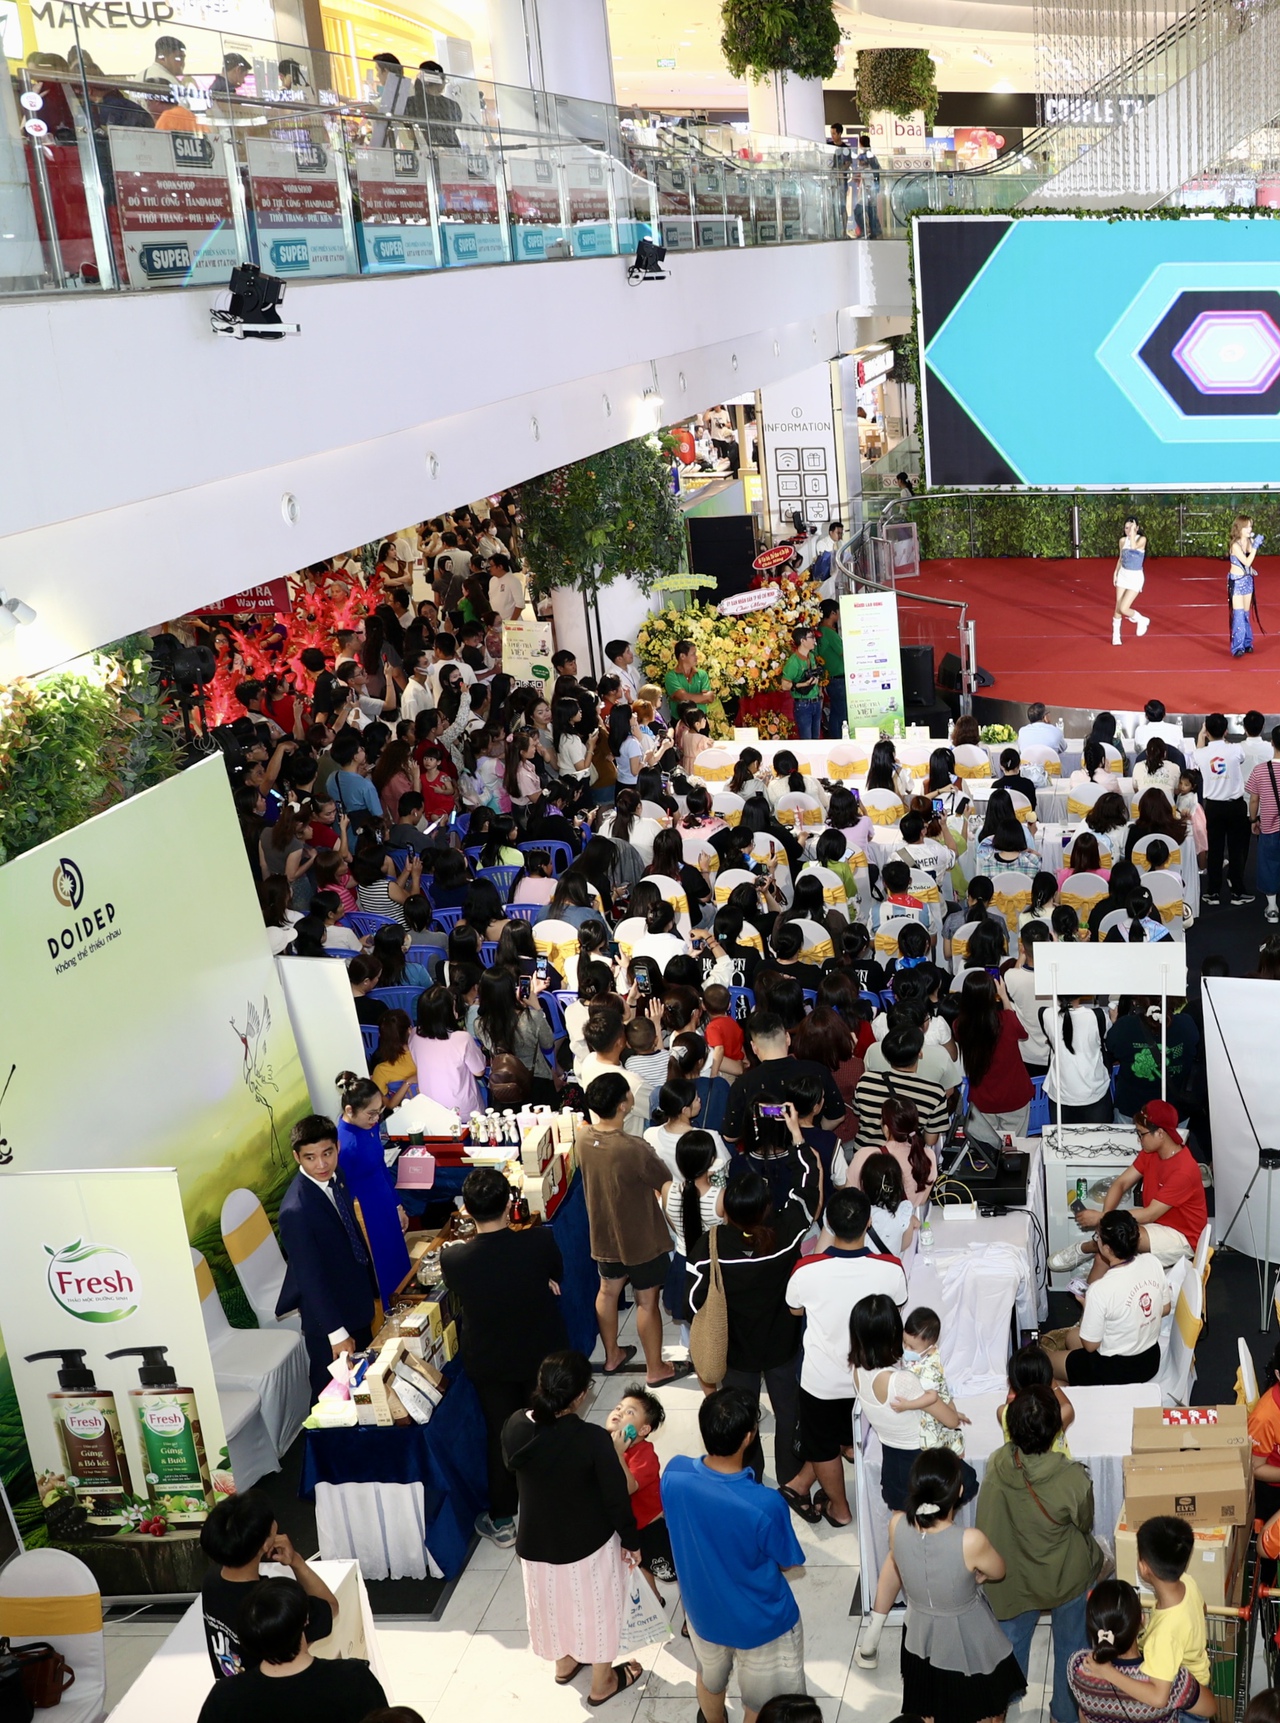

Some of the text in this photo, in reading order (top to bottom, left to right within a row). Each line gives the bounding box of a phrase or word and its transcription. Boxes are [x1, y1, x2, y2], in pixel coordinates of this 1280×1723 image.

[31, 1, 174, 28] MAKEUP
[1046, 98, 1114, 123] COUPLE
[895, 121, 922, 137] baa
[175, 138, 203, 157] SALE
[298, 148, 318, 163] SALE
[396, 156, 413, 171] SALE
[469, 158, 484, 172] SALE
[157, 180, 196, 190] WORKSHOP
[283, 184, 312, 194] WORKSHOP
[161, 194, 179, 206] CÔNG
[186, 195, 224, 207] HANDMADE
[305, 199, 334, 209] HANDMADE
[159, 213, 183, 224] TRANG
[285, 213, 303, 223] TRANG
[380, 241, 403, 256] SUPER
[458, 238, 477, 252] SUPER
[528, 234, 543, 249] SUPER
[152, 249, 190, 270] SUPER
[280, 246, 308, 262] SUPER
[217, 259, 237, 268] STATION
[765, 421, 831, 432] INFORMATION
[256, 586, 272, 596] RA
[236, 598, 274, 609] Way out
[47, 903, 115, 959] DOIDEP
[55, 957, 77, 975] Không
[89, 937, 106, 953] thiếu
[106, 928, 122, 943] nhau
[56, 1269, 133, 1295] Fresh
[1125, 1280, 1160, 1307] HIGHLANDS
[69, 1417, 102, 1427] Fresh
[149, 1413, 181, 1424] Fresh
[81, 1450, 104, 1458] Gừng
[161, 1448, 183, 1456] Gừng
[1176, 1504, 1195, 1512] ELYS
